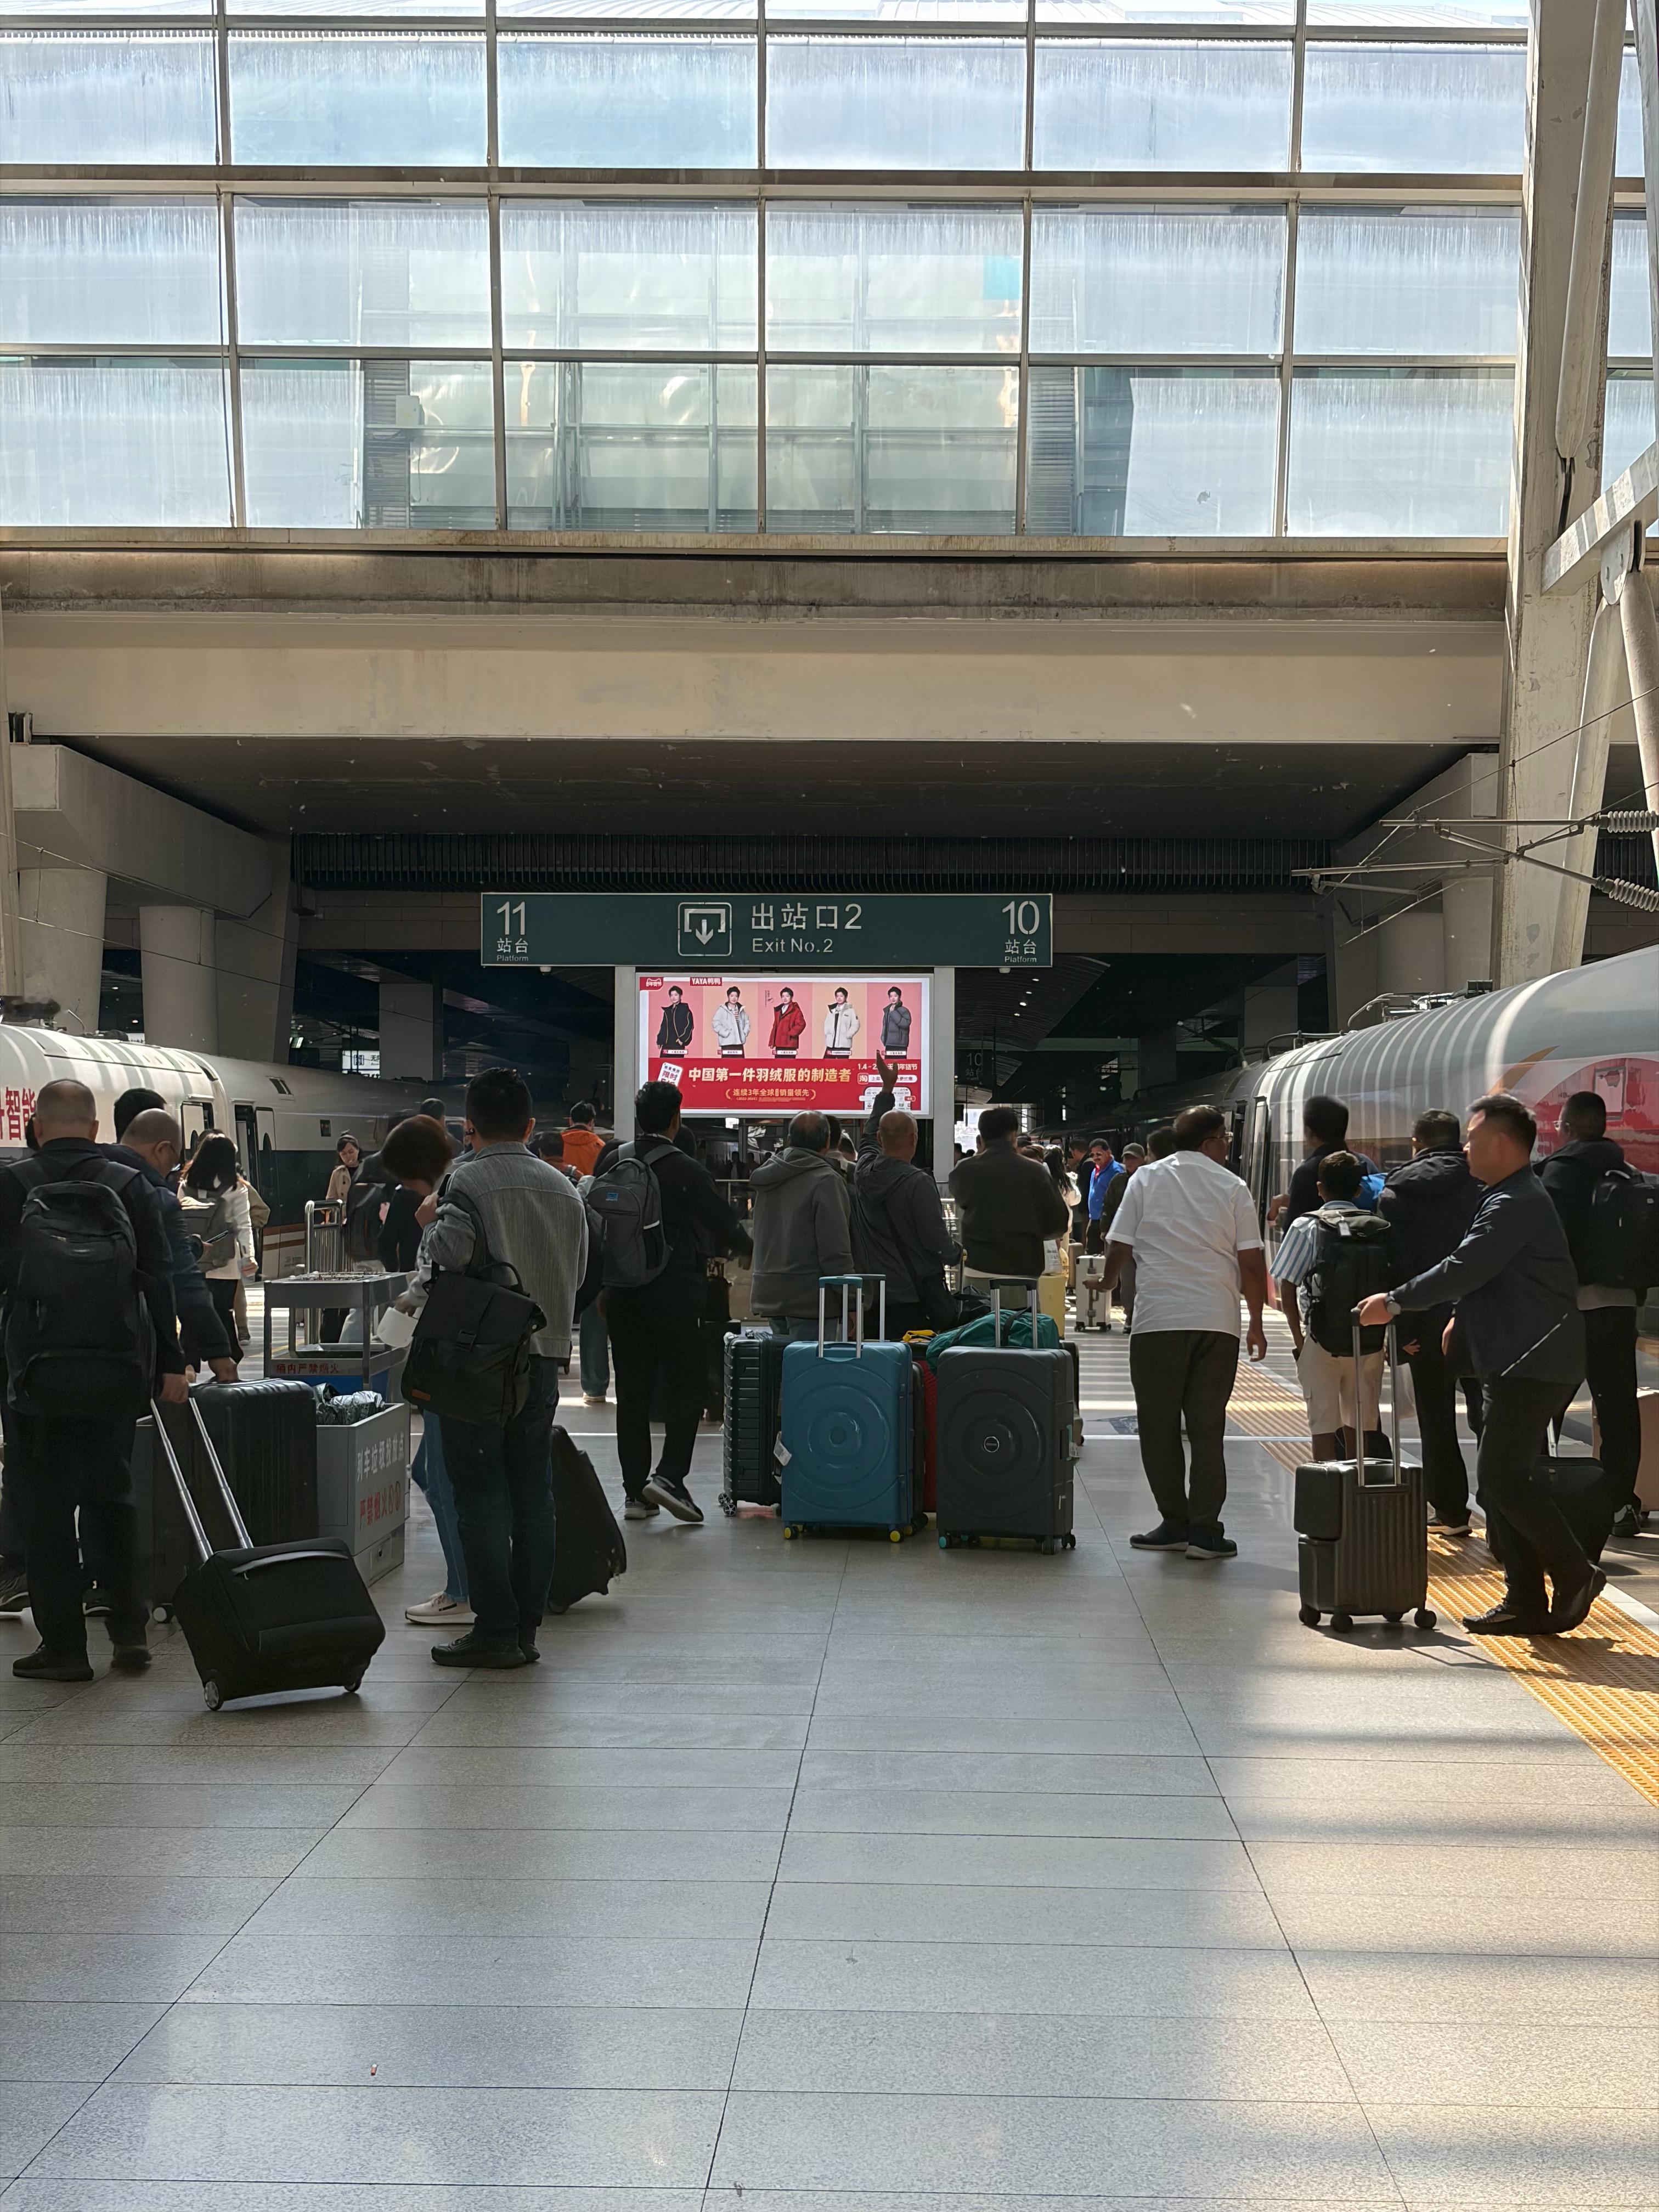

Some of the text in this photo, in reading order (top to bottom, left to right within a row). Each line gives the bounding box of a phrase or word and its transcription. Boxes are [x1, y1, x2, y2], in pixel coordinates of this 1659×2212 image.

[497, 901, 526, 935] 11
[1002, 901, 1040, 935] 10
[496, 938, 528, 953] 站台
[752, 938, 785, 952] Exit
[1005, 939, 1036, 955] 站台
[688, 1067, 851, 1082] 中国第一件羽绒服的制造者
[0, 1086, 36, 1141] 智能
[357, 1432, 404, 1482] 列车垃圾投放点
[359, 1489, 387, 1530] 严禁烟火
